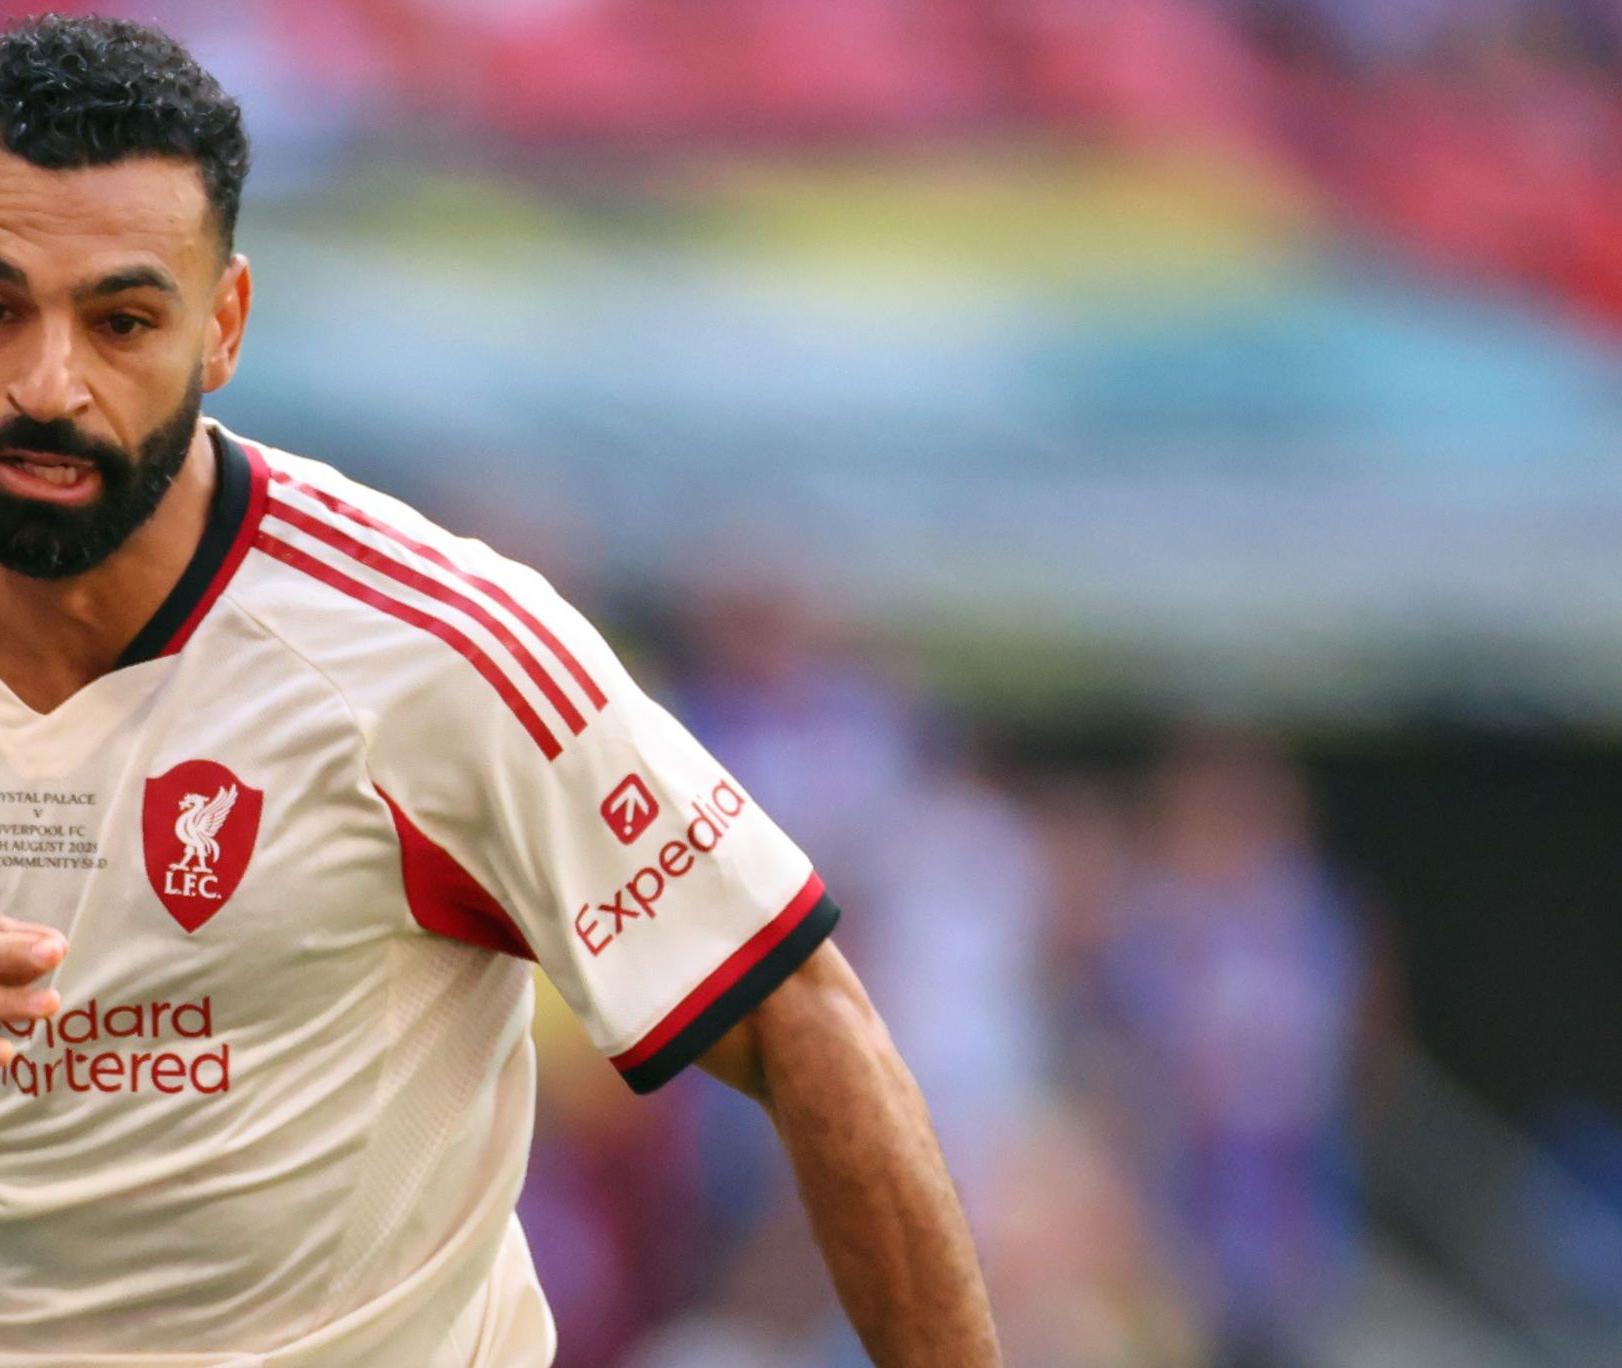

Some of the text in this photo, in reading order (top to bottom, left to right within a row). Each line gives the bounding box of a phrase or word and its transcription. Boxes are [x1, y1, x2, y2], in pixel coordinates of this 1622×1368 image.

[43, 793, 97, 805] PALACE
[68, 826, 86, 837] FC
[12, 840, 65, 852] AUGUST
[574, 778, 746, 957] Expedia
